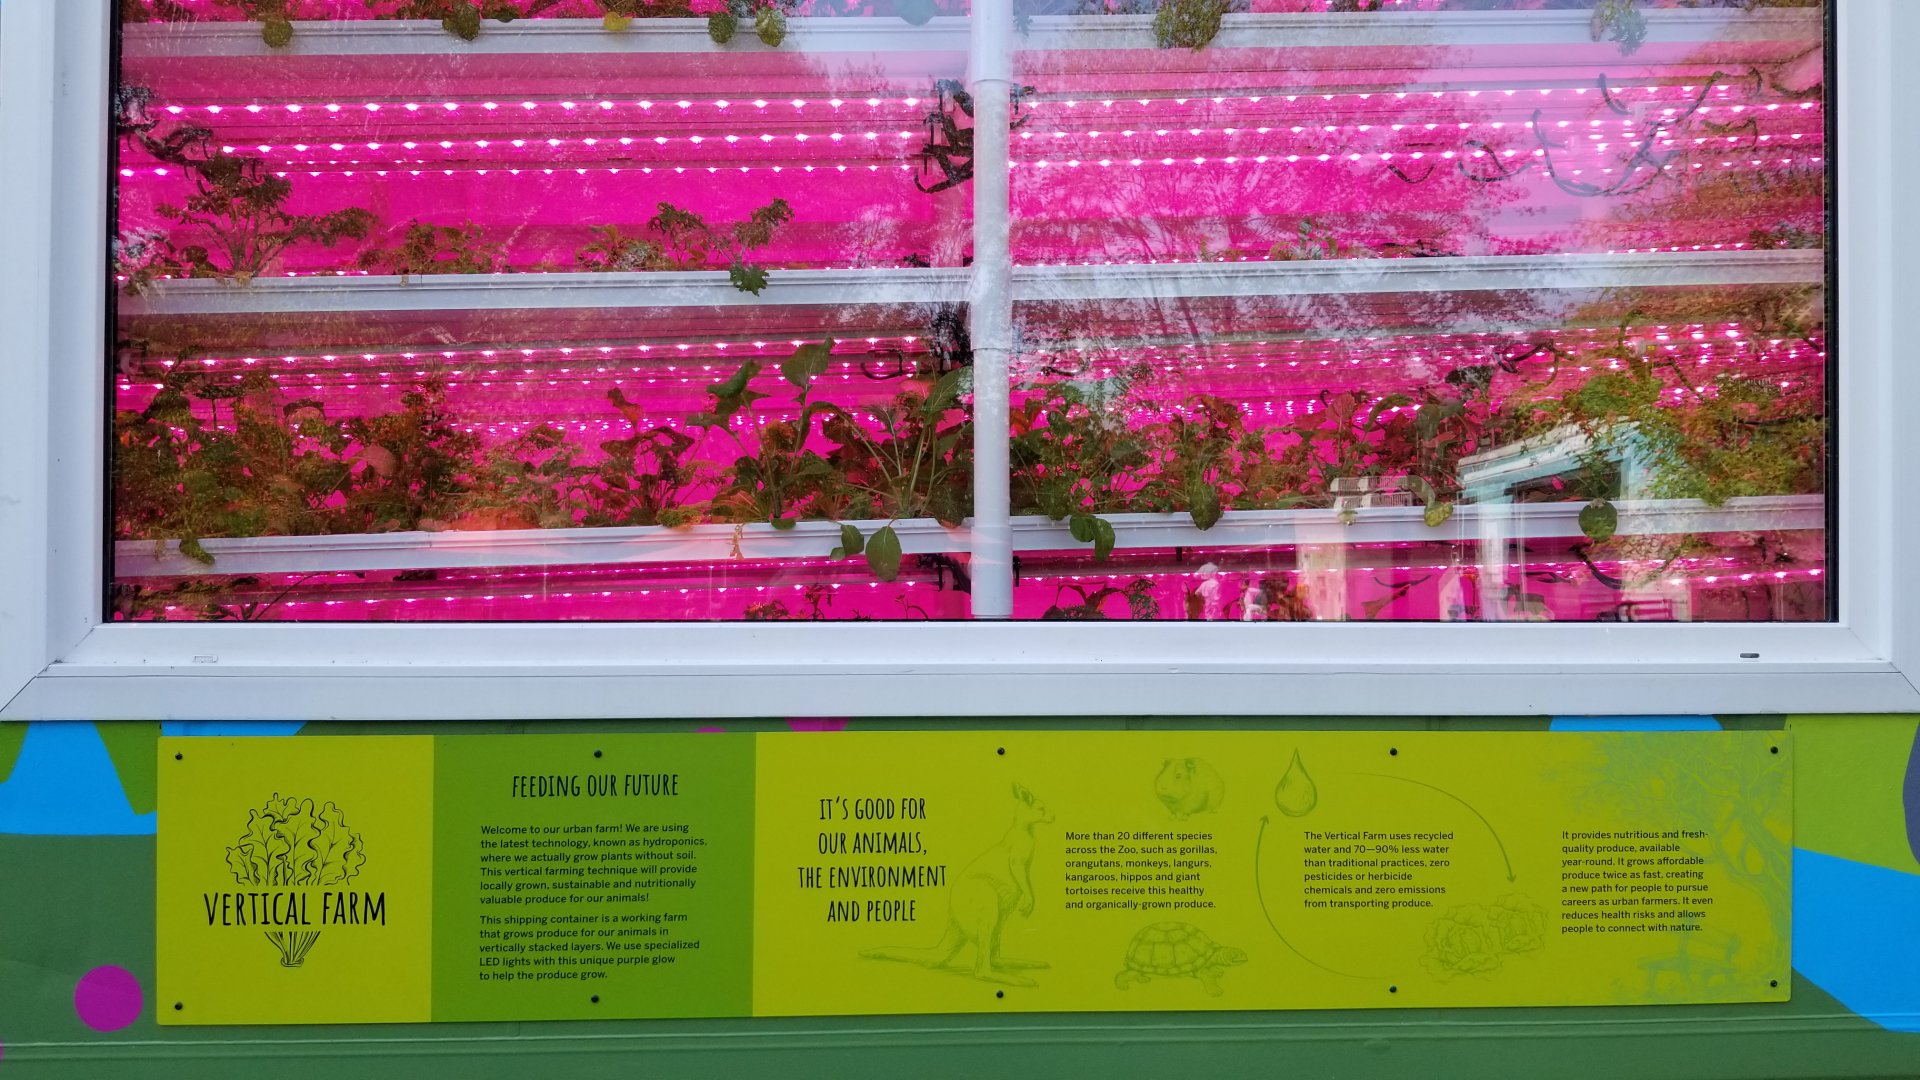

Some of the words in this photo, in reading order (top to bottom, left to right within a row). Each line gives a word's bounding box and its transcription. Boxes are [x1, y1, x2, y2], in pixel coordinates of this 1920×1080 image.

[512, 774, 580, 798] FEEDING
[587, 774, 617, 797] OUR
[624, 773, 678, 796] FUTURE
[819, 795, 848, 820] IT'S
[854, 798, 894, 820] GOOD
[901, 797, 926, 819] FOR
[480, 825, 527, 834] Welcome
[529, 825, 540, 834] to
[562, 824, 592, 833] urban
[594, 823, 622, 833] farm!
[625, 823, 640, 832] We
[661, 823, 689, 834] using
[1065, 831, 1090, 840] More
[1092, 831, 1114, 840] than
[1117, 831, 1130, 840] 20
[1132, 831, 1174, 840] different
[1176, 833, 1212, 842] species
[1303, 831, 1322, 840] The
[1324, 831, 1360, 840] Vertical
[1362, 831, 1386, 840] Farm
[1413, 831, 1453, 841] recycled
[1562, 830, 1569, 839] It
[1571, 830, 1611, 841] provides
[1613, 830, 1659, 839] nutritious
[1661, 829, 1678, 838] and
[1681, 829, 1708, 838] fresh-
[818, 831, 847, 854] OUR
[852, 831, 927, 856] ANIMALS,
[1099, 845, 1116, 854] the
[1117, 844, 1138, 854] Zoo,
[1140, 845, 1164, 853] such
[1179, 844, 1217, 855] gorillas,
[1303, 845, 1330, 853] water
[1333, 845, 1351, 853] and
[1401, 844, 1420, 853] less
[1422, 844, 1449, 853] water
[1561, 844, 1594, 854] quality
[1596, 843, 1637, 854] produce,
[1639, 843, 1680, 852] available
[480, 853, 511, 862] where
[513, 854, 528, 862] we
[530, 852, 571, 864] actually
[572, 853, 598, 863] grow
[600, 851, 632, 862] plants
[634, 850, 673, 860] without
[676, 850, 696, 859] soil.
[1303, 858, 1326, 867] than
[1328, 858, 1378, 867] traditional
[1380, 858, 1427, 868] practices,
[1561, 857, 1615, 868] year-round.
[1617, 857, 1624, 865] It
[1626, 858, 1654, 867] grows
[1656, 856, 1704, 865] affordable
[1065, 859, 1122, 869] orangutans,
[1125, 858, 1170, 869] monkeys,
[1173, 858, 1211, 869] langurs,
[479, 867, 502, 877] This
[504, 866, 542, 876] vertical
[544, 866, 584, 877] farming
[587, 865, 638, 876] technique
[640, 864, 657, 874] will
[659, 864, 697, 875] provide
[797, 866, 822, 888] THE
[829, 864, 946, 889] ENVIRONMENT
[1561, 870, 1600, 881] produce
[1602, 870, 1627, 879] twice
[1665, 869, 1704, 880] creating
[1065, 872, 1118, 883] kangaroos,
[1120, 872, 1152, 883] hippos
[1154, 872, 1173, 881] and
[1175, 872, 1200, 883] giant
[480, 880, 513, 892] locally
[552, 879, 610, 889] sustainable
[612, 879, 632, 888] and
[634, 878, 696, 889] nutritionally
[1065, 886, 1108, 895] tortoises
[1111, 887, 1145, 895] receive
[1147, 885, 1166, 894] this
[1168, 885, 1204, 896] healthy
[1303, 885, 1352, 894] chemicals
[1354, 885, 1372, 894] and
[1398, 885, 1446, 894] emissions
[1591, 883, 1612, 894] path
[1614, 883, 1628, 892] for
[1630, 883, 1662, 894] people
[1664, 883, 1674, 891] to
[1676, 884, 1708, 893] pursue
[479, 894, 522, 904] valuable
[524, 894, 566, 905] produce
[569, 893, 584, 903] for
[606, 892, 648, 902] animals!
[1064, 900, 1083, 909] and
[1085, 899, 1171, 910] organically-grown
[1174, 899, 1216, 910] produce.
[1304, 898, 1327, 908] from
[1329, 899, 1389, 910] transporting
[1391, 898, 1433, 909] produce.
[203, 891, 311, 926] VERTICAL
[322, 891, 385, 926] FARM
[826, 900, 860, 922] AND
[866, 899, 916, 922] PEOPLE
[1561, 910, 1599, 919] reduces
[1601, 910, 1630, 919] health
[1632, 910, 1655, 919] risks
[1657, 909, 1674, 918] and
[1676, 909, 1706, 918] allows
[479, 929, 500, 939] that
[502, 930, 534, 940] grows
[536, 928, 578, 940] produce
[580, 927, 595, 937] for
[617, 926, 656, 936] animals
[659, 926, 668, 935] in
[1561, 924, 1593, 935] people
[1595, 924, 1605, 932] to
[1607, 923, 1645, 932] connect
[1647, 923, 1668, 931] with
[1670, 923, 1702, 931] nature.
[479, 942, 526, 954] vertically
[528, 942, 568, 952] stacked
[570, 941, 603, 953] layers.
[605, 941, 621, 950] We
[623, 942, 641, 950] use
[644, 939, 700, 952] specialized
[479, 957, 500, 966] LED
[502, 957, 530, 968] lights
[533, 956, 555, 965] with
[557, 956, 577, 965] this
[579, 955, 614, 966] unique
[616, 954, 649, 966] purple
[651, 954, 675, 965] glow
[479, 971, 490, 980] to
[492, 970, 514, 982] help
[516, 970, 534, 980] the
[536, 969, 578, 981] produce
[580, 971, 608, 981] grow.
